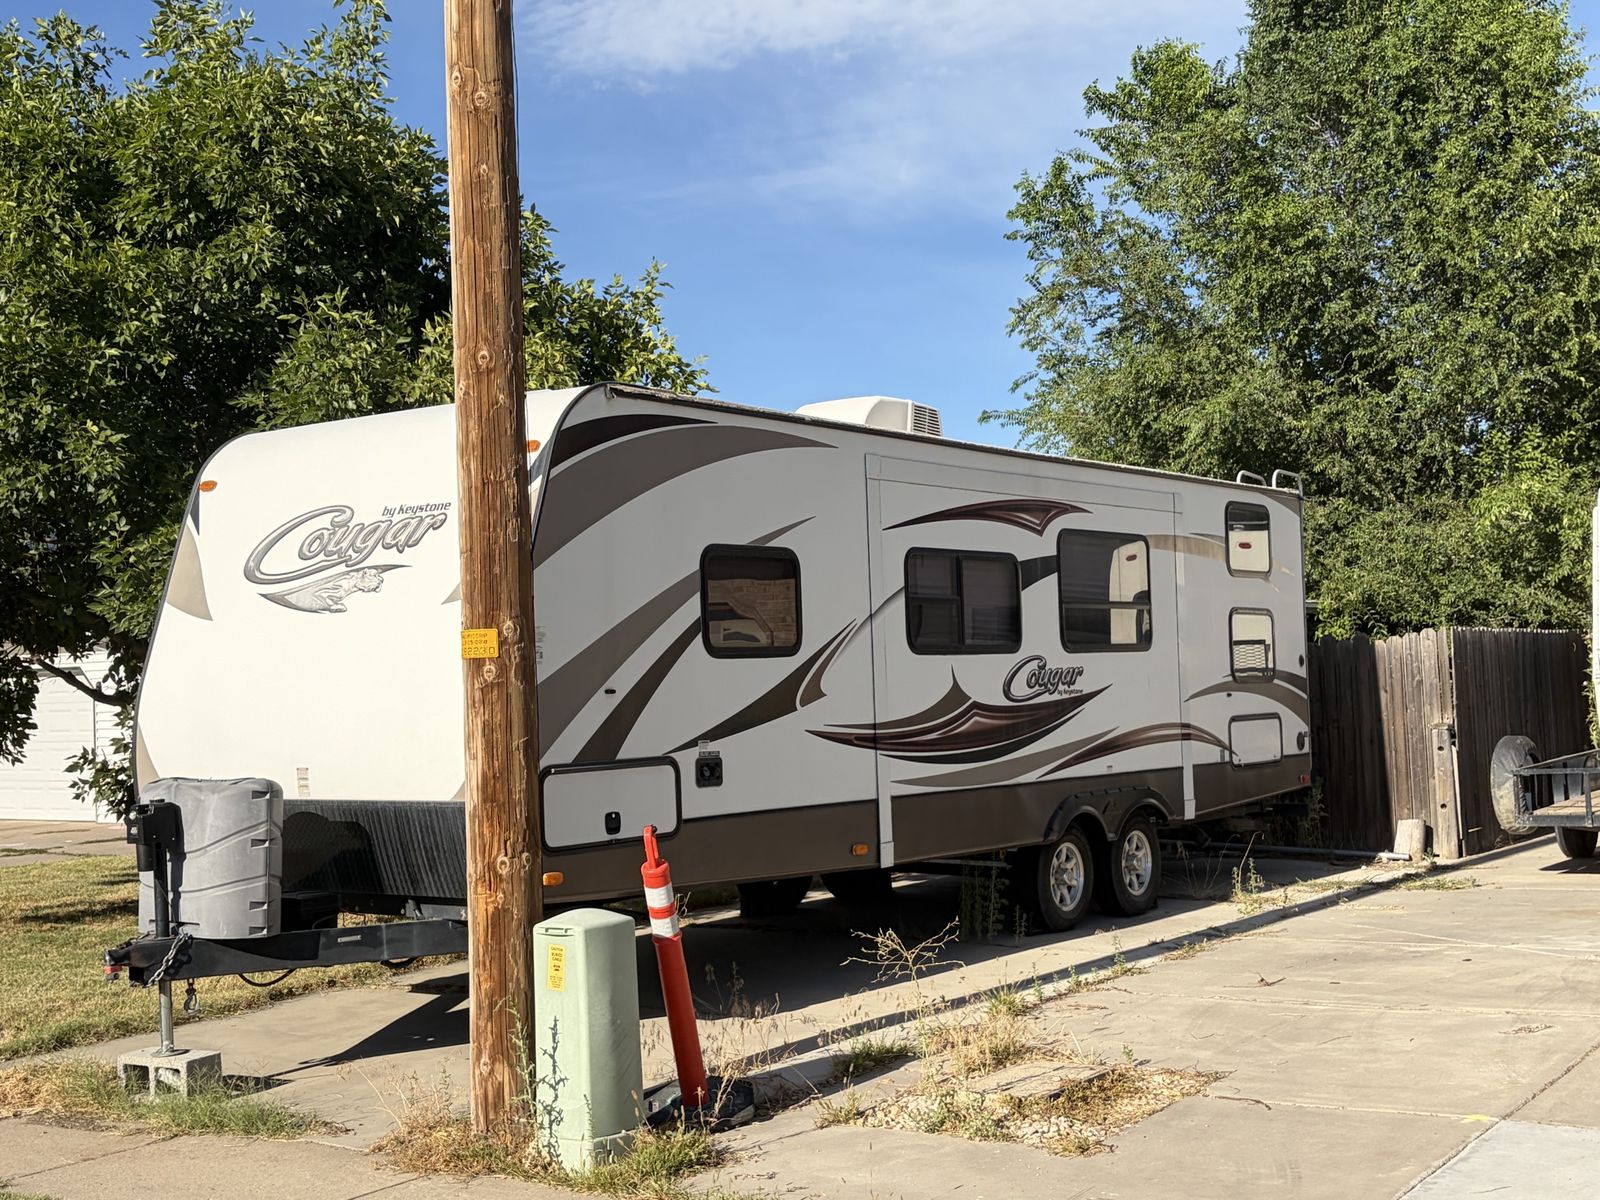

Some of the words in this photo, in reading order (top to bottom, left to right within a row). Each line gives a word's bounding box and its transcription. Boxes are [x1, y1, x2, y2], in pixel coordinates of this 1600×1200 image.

[382, 506, 396, 517] by
[397, 502, 452, 516] Keystone
[243, 504, 448, 585] Cougar
[1002, 654, 1084, 703] Cougar
